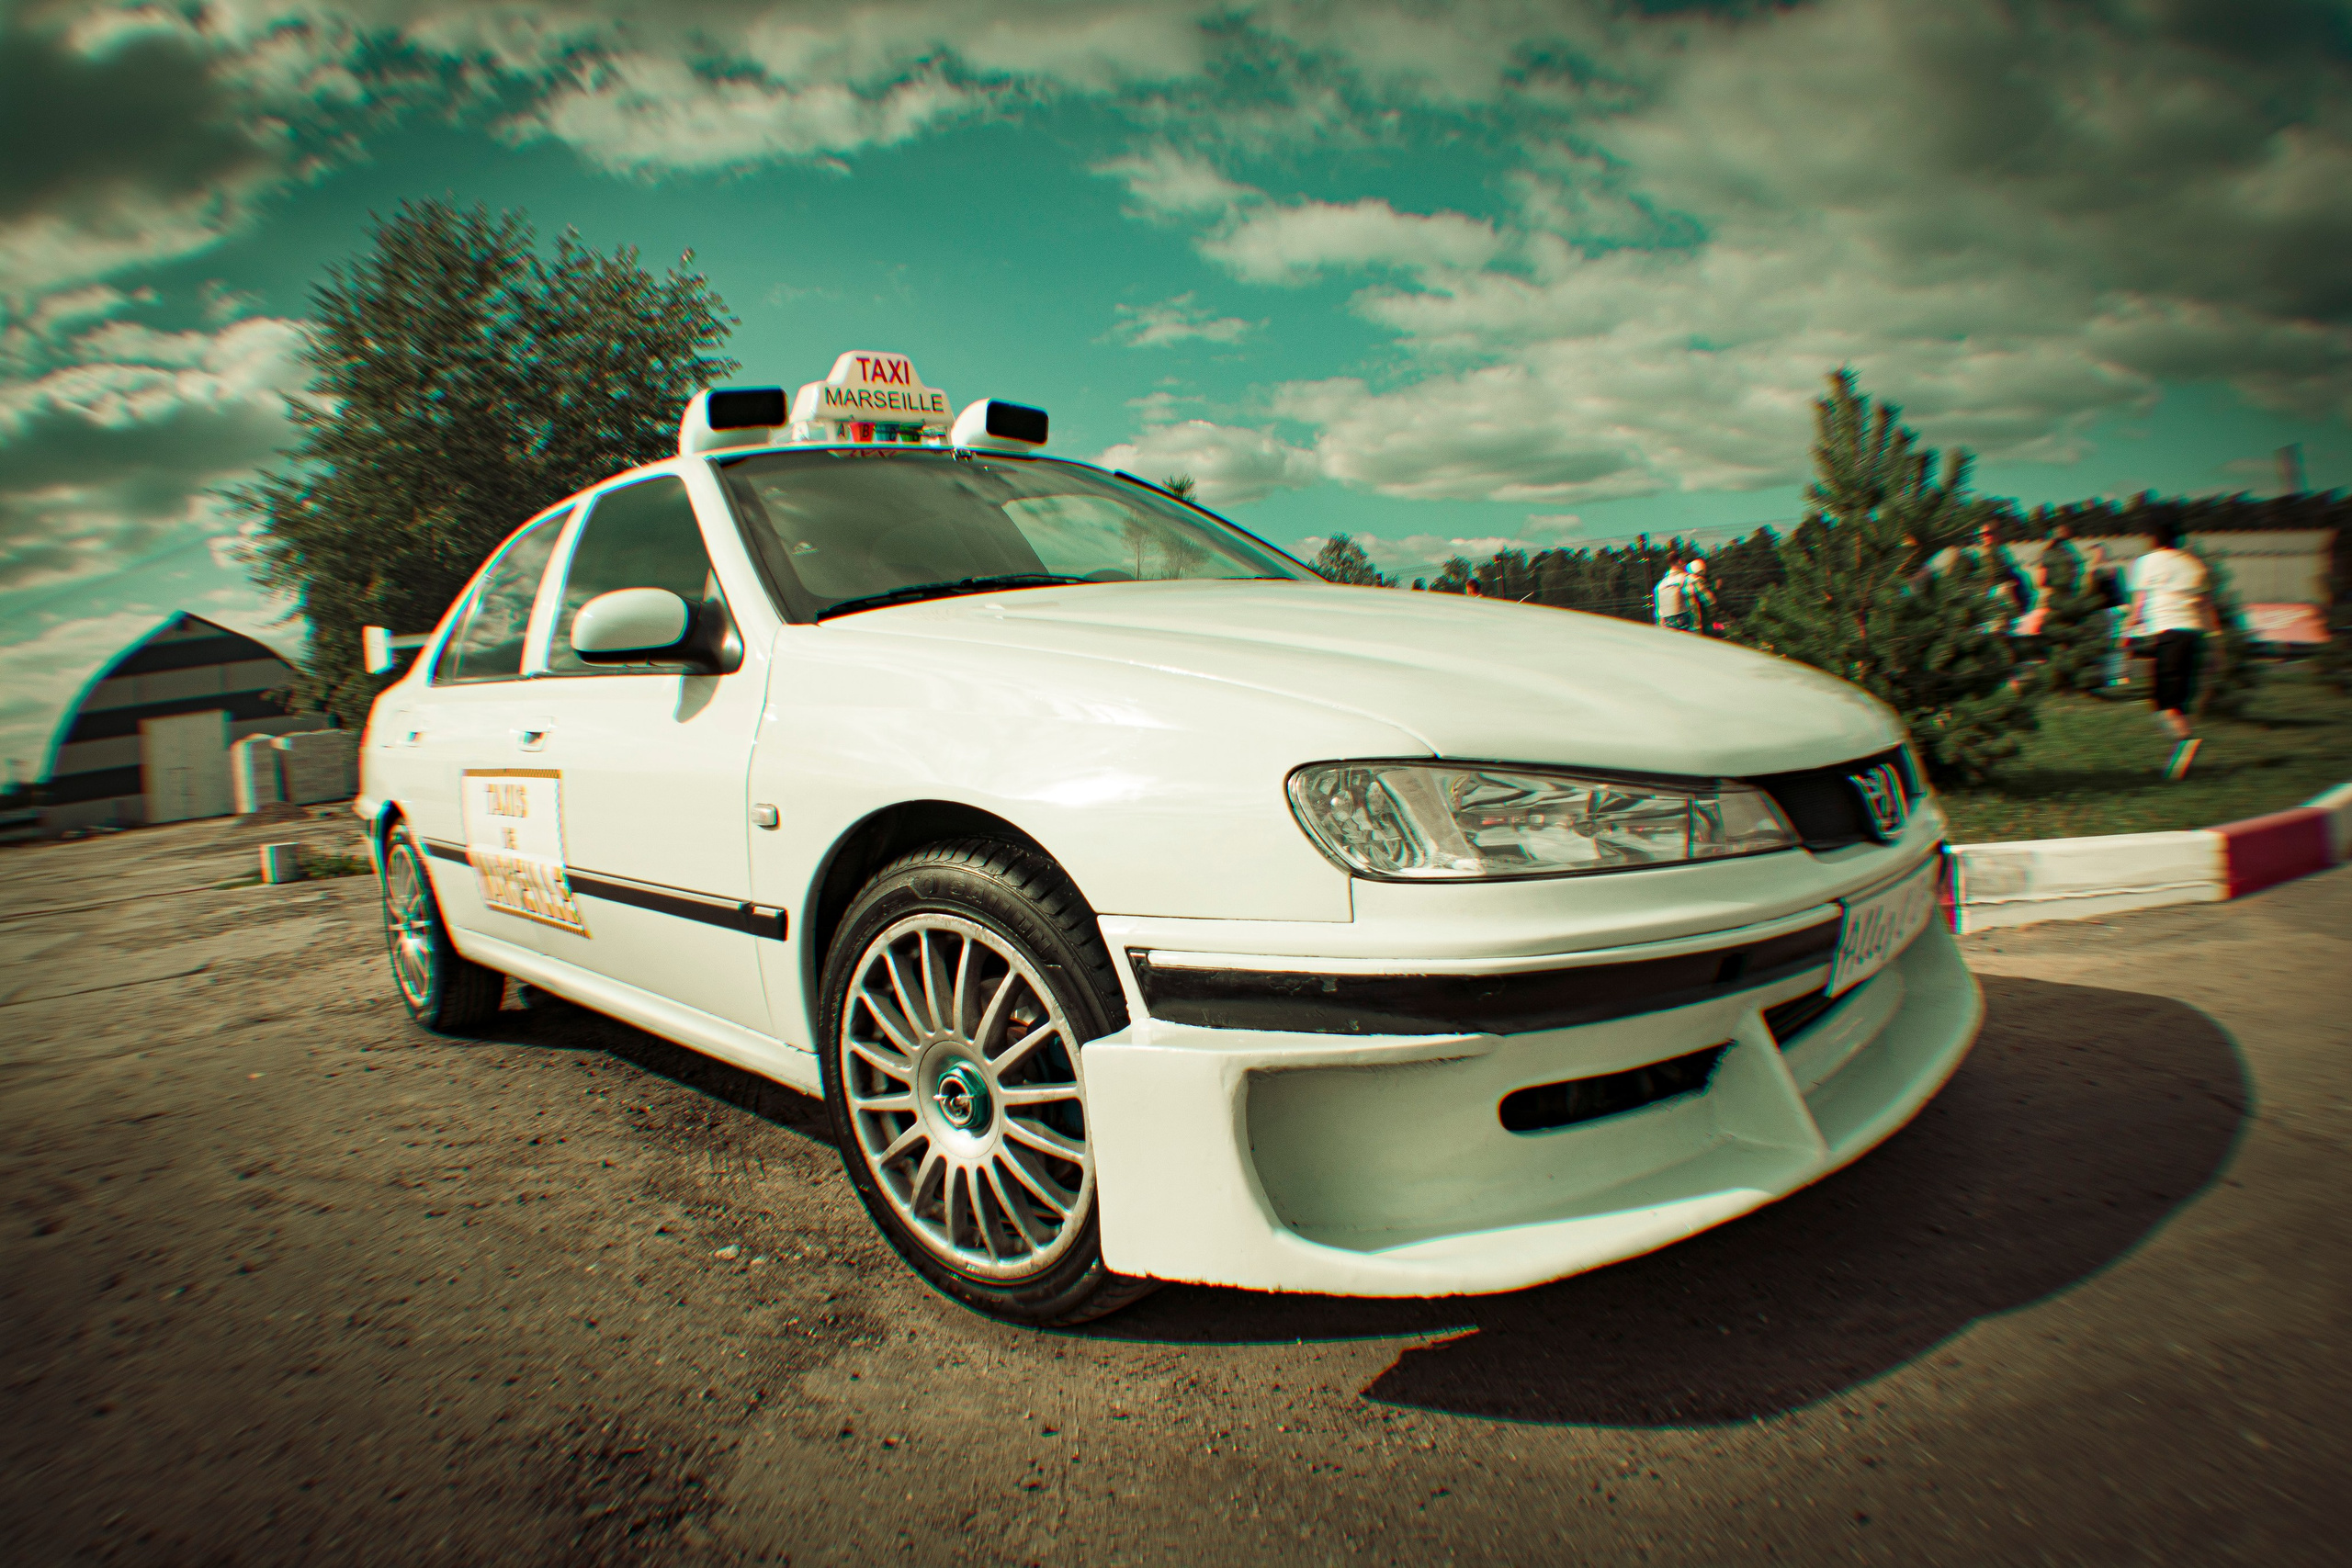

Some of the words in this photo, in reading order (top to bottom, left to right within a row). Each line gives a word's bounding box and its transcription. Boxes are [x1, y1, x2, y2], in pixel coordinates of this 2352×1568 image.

[856, 356, 910, 386] TAXI
[825, 387, 944, 413] MARSEILLE
[862, 423, 869, 437] B
